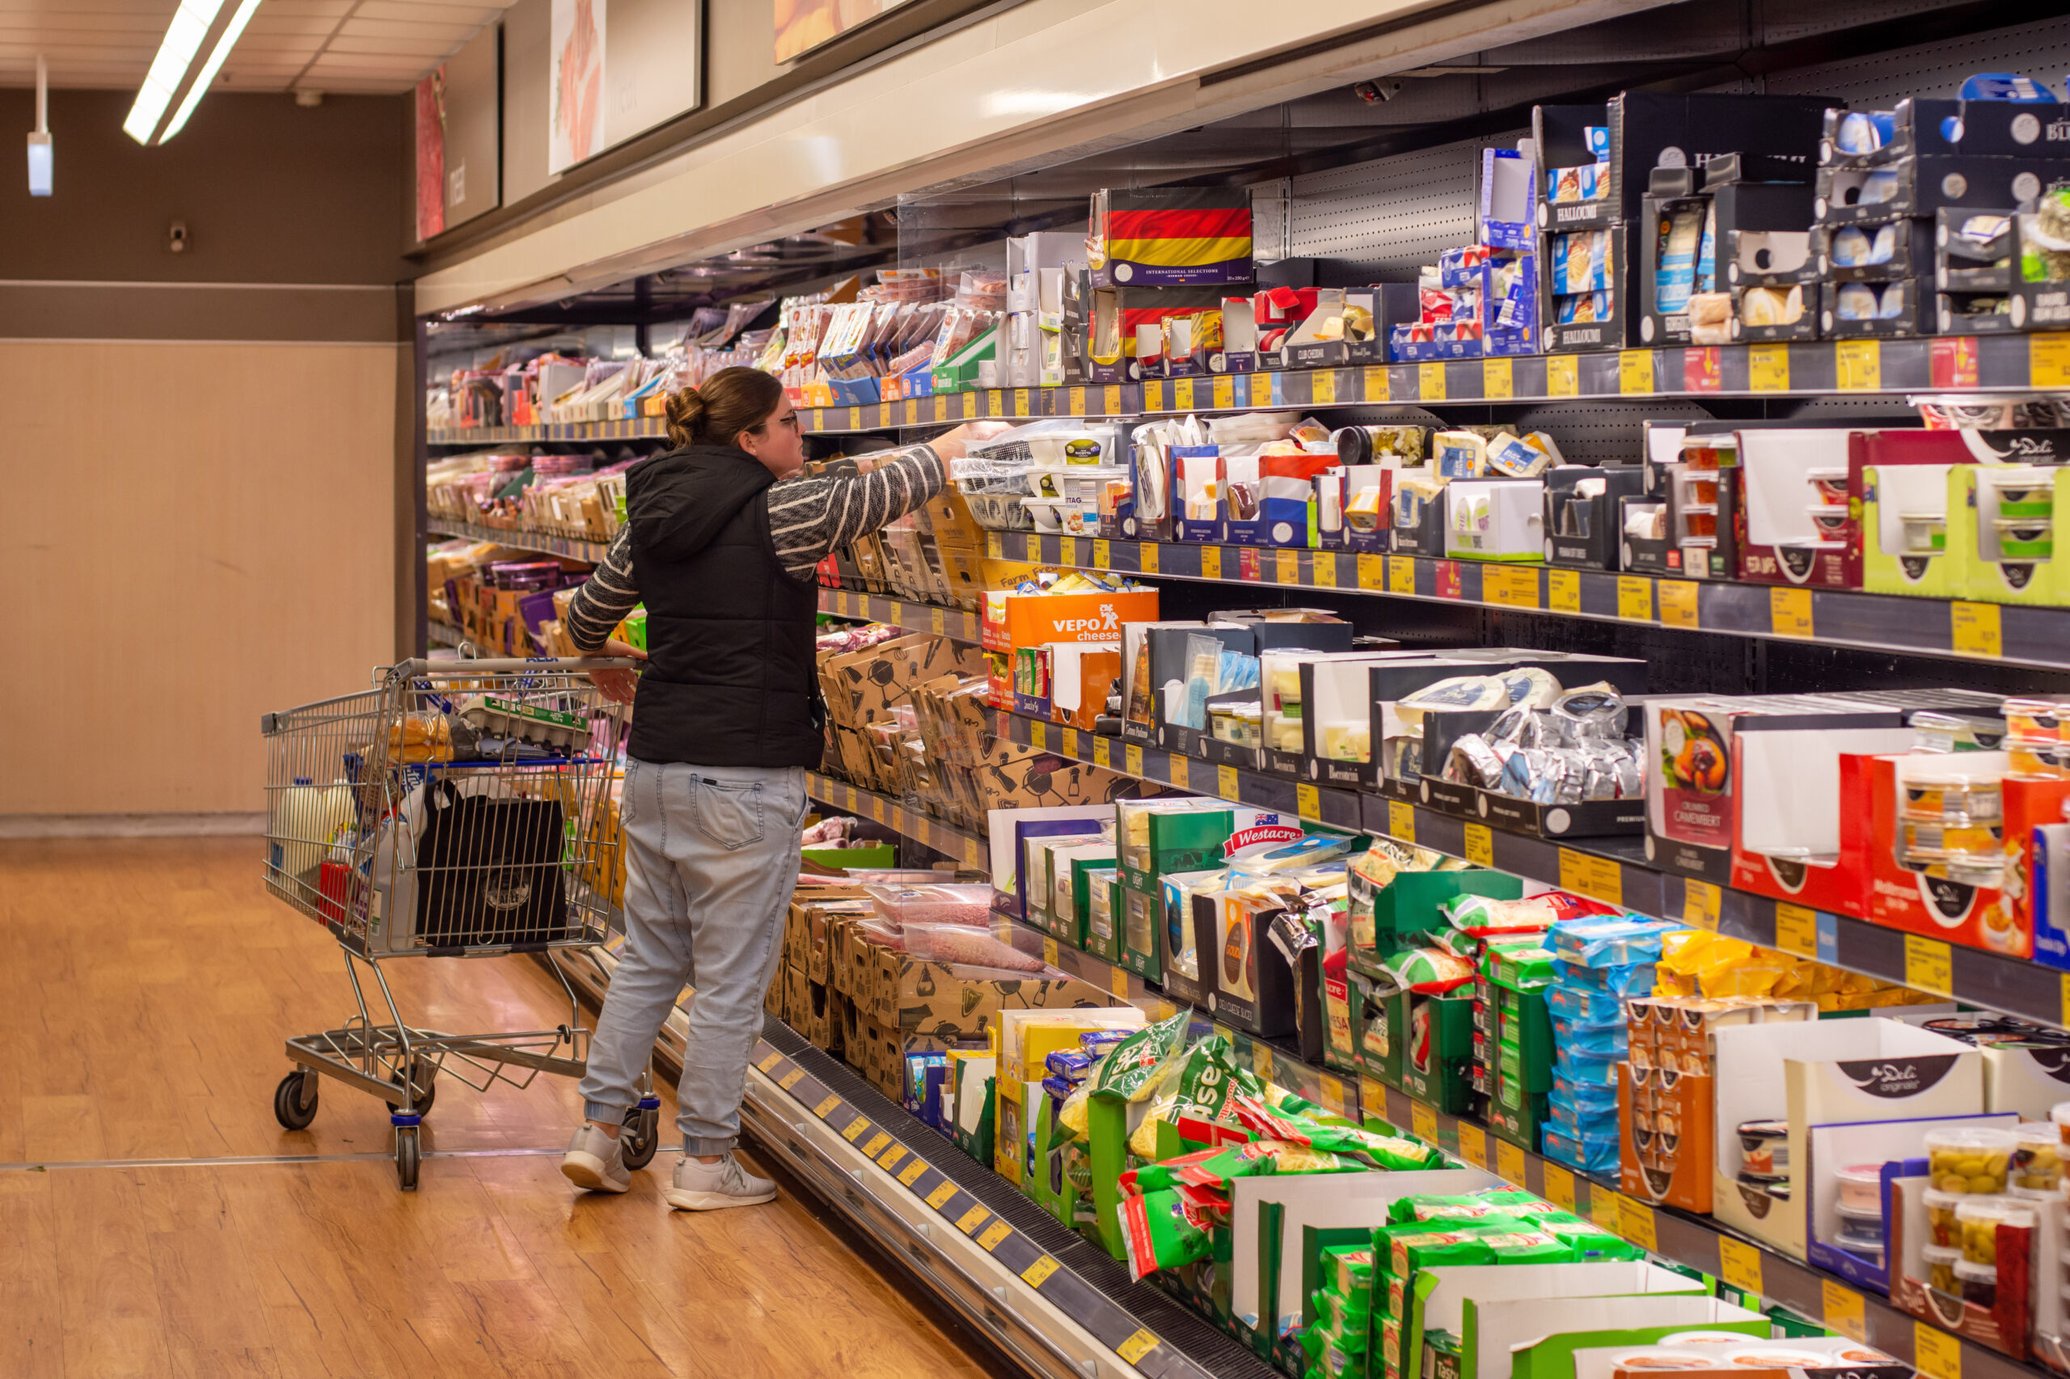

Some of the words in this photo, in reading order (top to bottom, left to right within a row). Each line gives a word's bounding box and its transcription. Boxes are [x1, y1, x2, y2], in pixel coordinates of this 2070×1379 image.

[1557, 204, 1597, 222] HALLOUMI
[1563, 328, 1601, 344] HALLOUMI
[2018, 437, 2053, 455] Deli
[1000, 575, 1029, 588] Farm
[1053, 618, 1100, 632] VEPO
[1329, 764, 1359, 782] Bocconcini
[1681, 801, 1710, 813] CRUMBED
[1673, 811, 1721, 827] CAMEMBERT
[1239, 829, 1297, 846] Westacre
[1881, 1064, 1917, 1082] Deli
